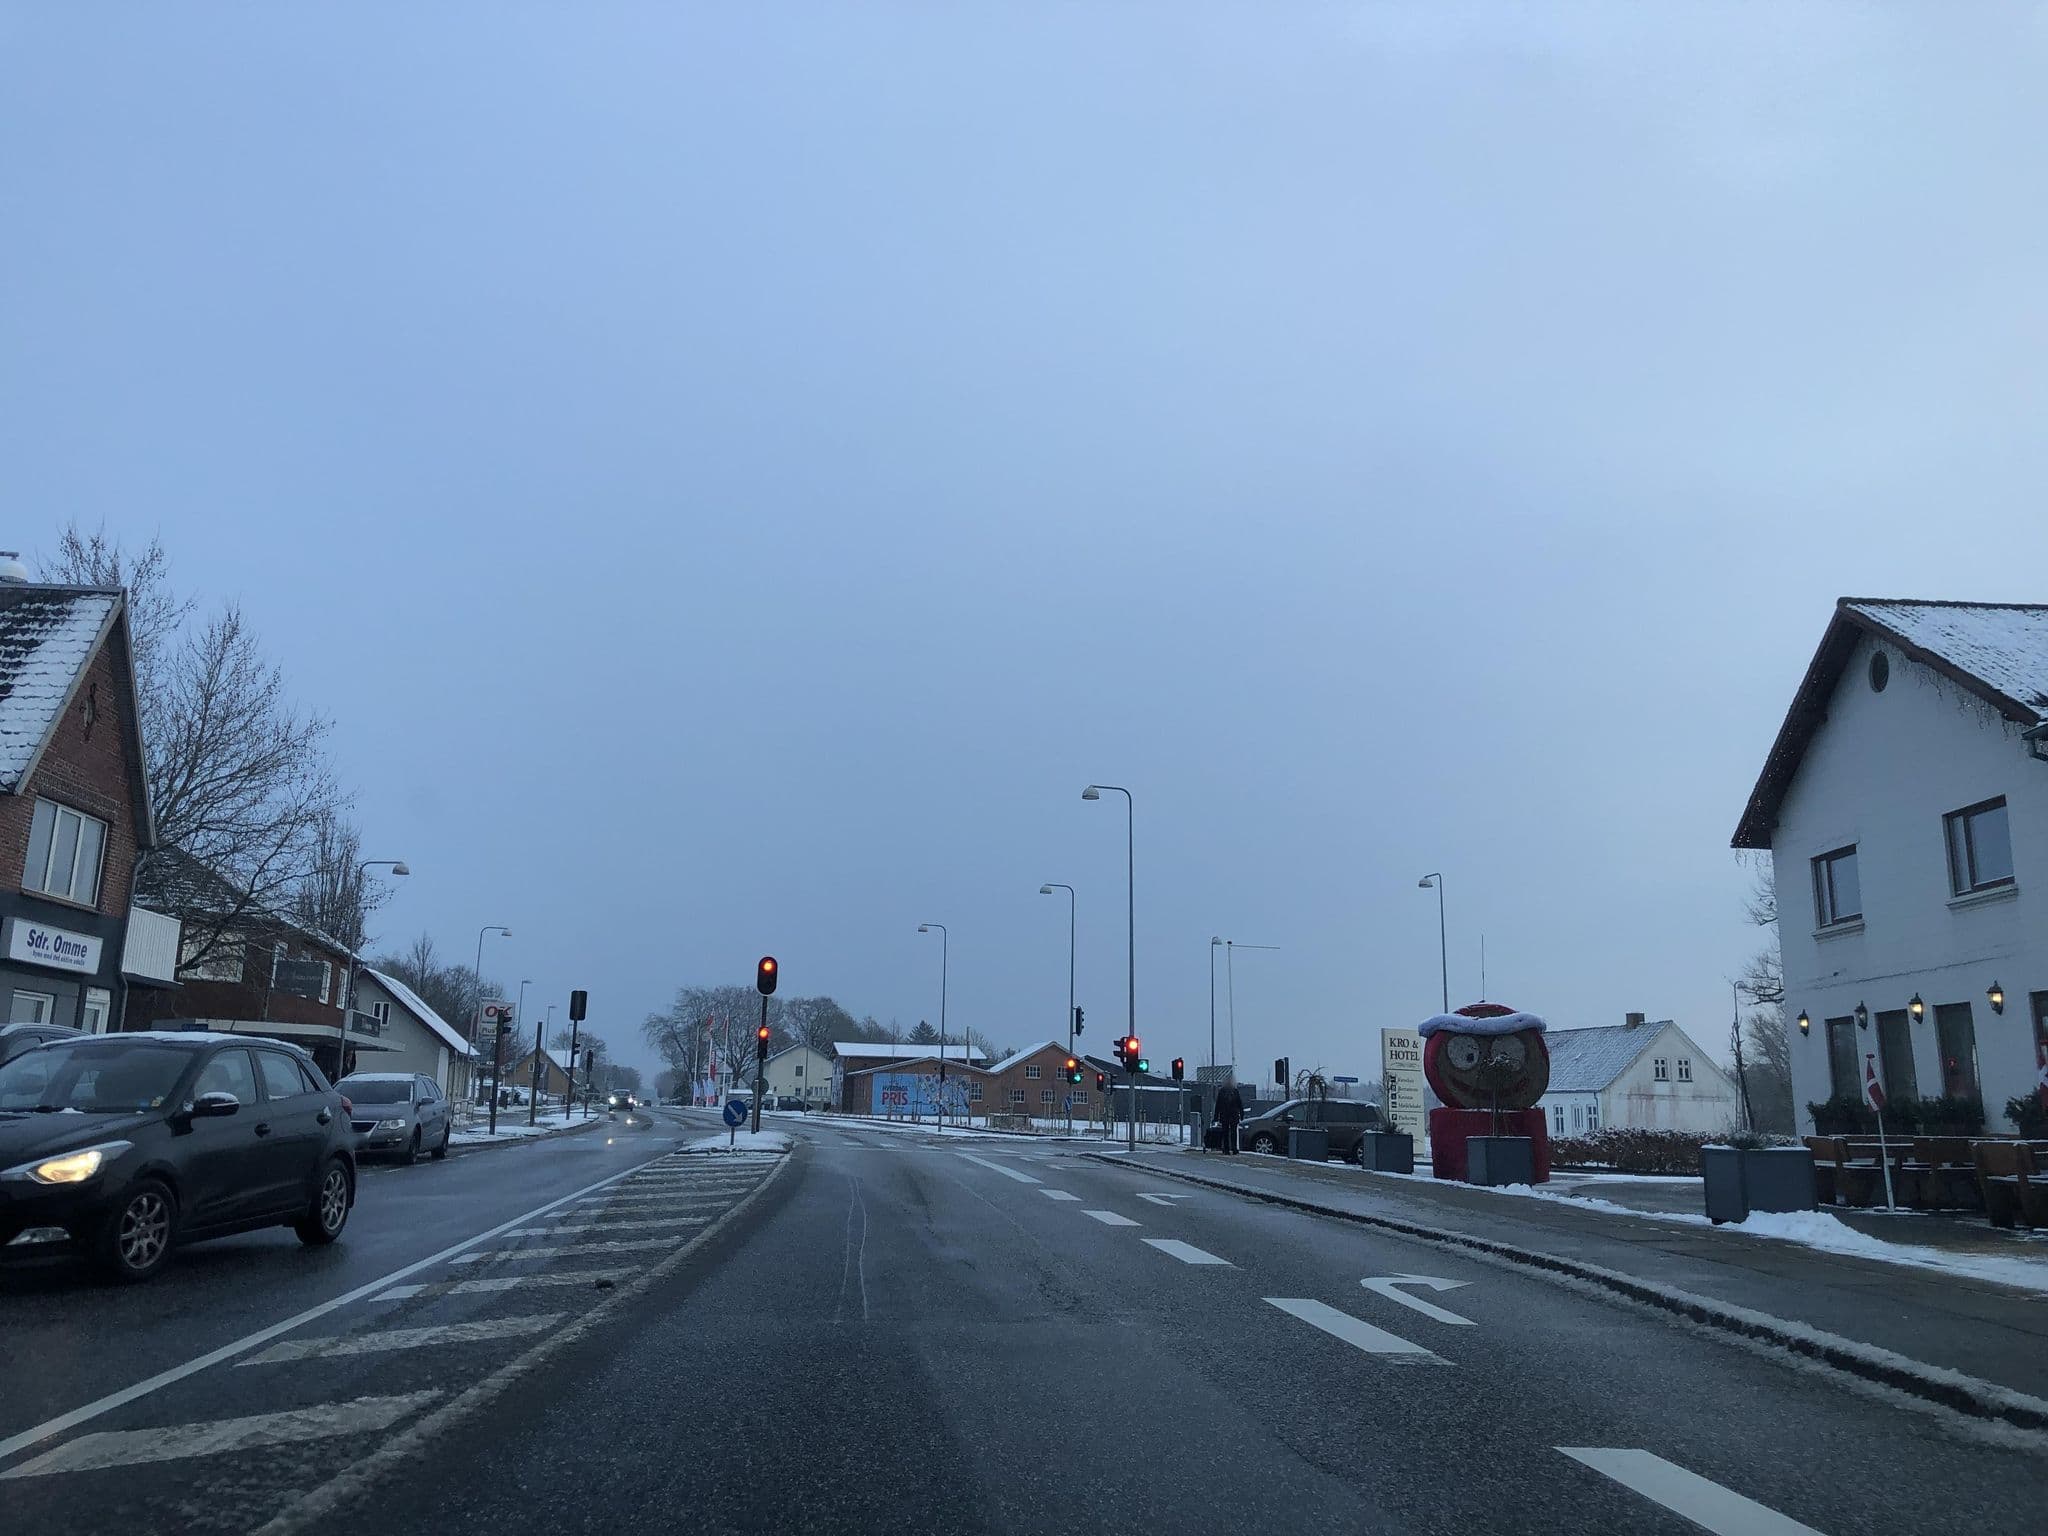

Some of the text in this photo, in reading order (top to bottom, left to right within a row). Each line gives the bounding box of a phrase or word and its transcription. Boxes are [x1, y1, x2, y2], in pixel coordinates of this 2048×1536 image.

[27, 928, 88, 958] Sdr. Omme
[1389, 1037, 1419, 1049] KRO &
[1390, 1050, 1420, 1061] HOTEL
[882, 1091, 908, 1105] PRIS
